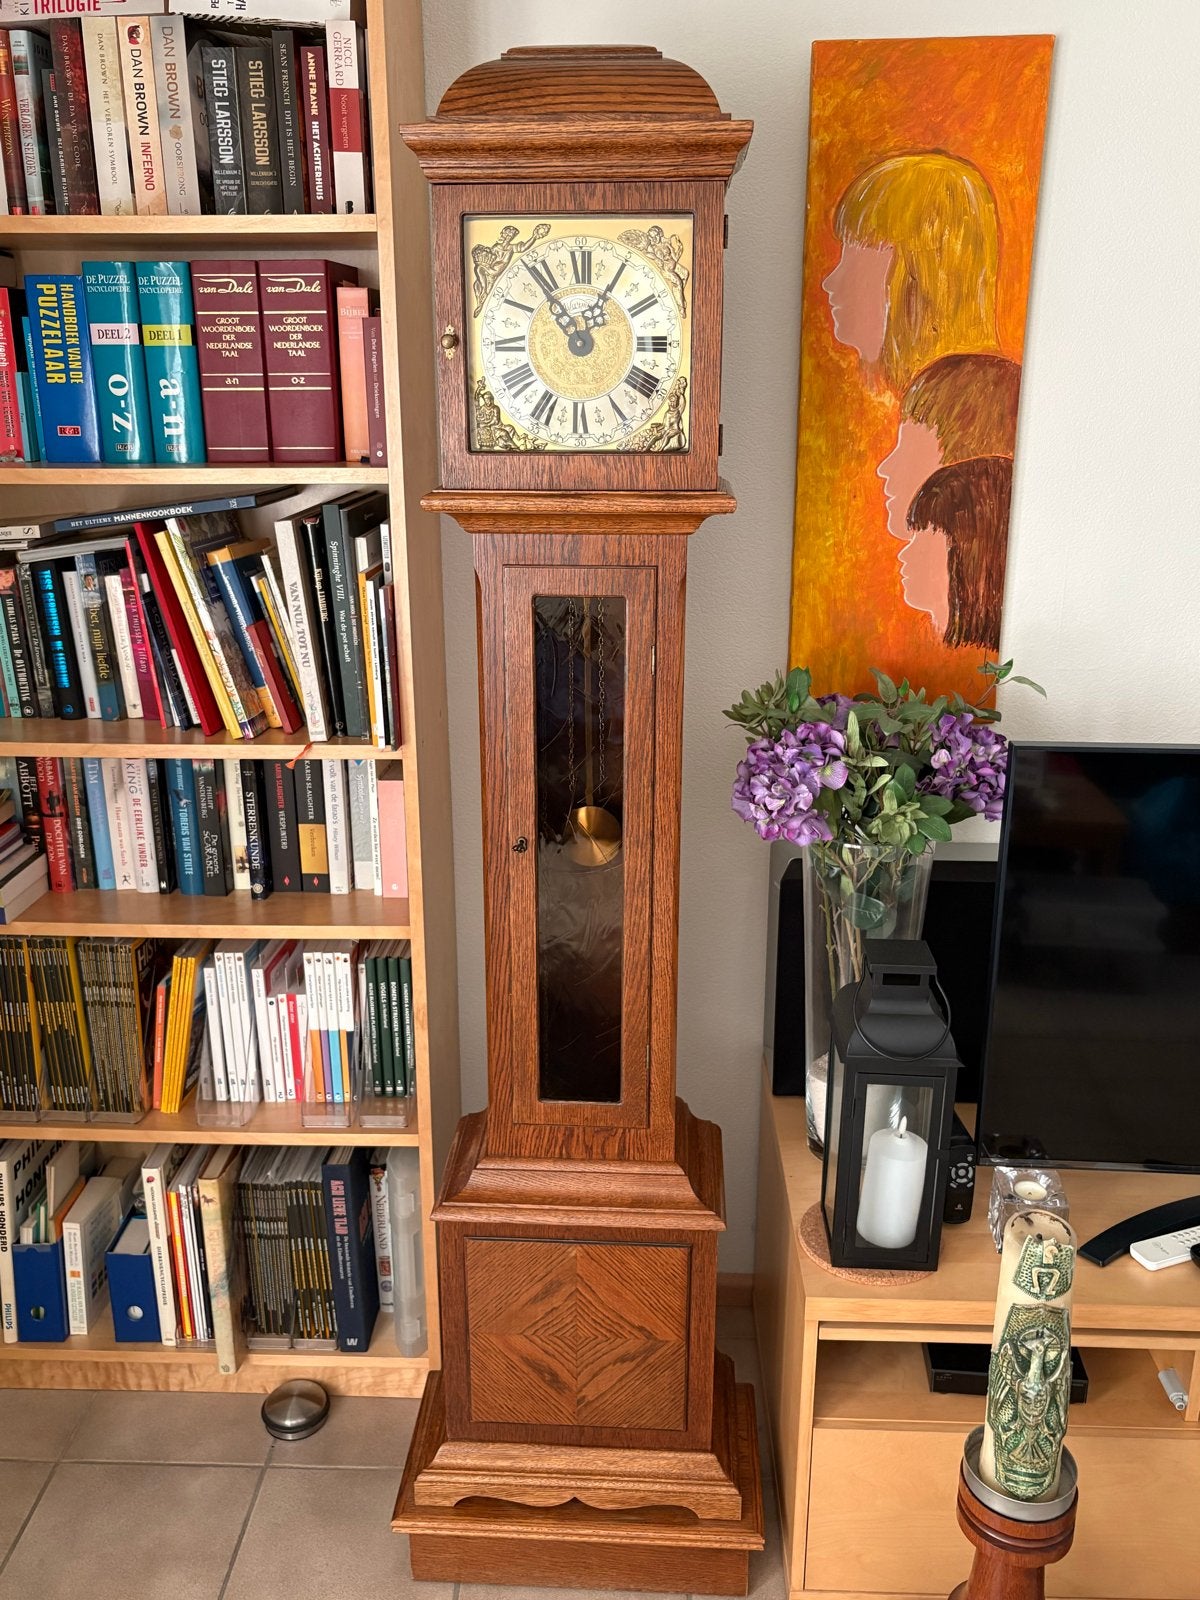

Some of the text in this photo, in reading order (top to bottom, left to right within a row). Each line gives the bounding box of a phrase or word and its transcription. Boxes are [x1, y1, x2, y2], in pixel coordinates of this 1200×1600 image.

[97, 33, 105, 50] DAN
[279, 43, 287, 67] SEAN
[343, 37, 353, 68] NICCI
[100, 53, 108, 85] BROWN
[332, 31, 344, 86] GERRARD
[61, 35, 81, 168] DAN BROWN DE DA VINCI CODE
[281, 69, 291, 105] FRENCH
[131, 48, 155, 191] DAN BROWN INFERNO
[161, 26, 187, 196] DAN BROWN OORSPRONG
[212, 59, 234, 164] STIEG LARSSON
[248, 60, 270, 165] STIEG LARSSON
[307, 51, 324, 201] ANNE FRANK HET ACHTERHUIS
[340, 94, 350, 149] Nooit vergeten
[19, 98, 37, 177] VERLOREN SEIZOEN
[105, 108, 114, 147] VERLOREN
[286, 129, 292, 137] IS
[286, 139, 294, 157] HET
[108, 149, 118, 185] SYMBOOL
[288, 160, 296, 186] BEGIN
[574, 237, 587, 246] 60
[86, 274, 130, 284] DE PUZZEL
[138, 275, 183, 286] DE PUZZEL
[569, 250, 592, 285] XII
[87, 285, 131, 293] ENCYCLOPEDIE
[139, 286, 183, 294] ENCYCLOPEDIE
[215, 278, 254, 294] Dale
[283, 278, 321, 293] Dale
[216, 317, 239, 325] GROOT
[283, 316, 307, 324] GROOT
[628, 293, 659, 318] II
[36, 284, 66, 384] PUZZELAAR
[60, 284, 84, 384] HANDBOEK VAN DE
[97, 328, 131, 340] DEEL 2
[149, 329, 182, 341] DEEL 1
[202, 325, 256, 333] WOORDENBOEK
[273, 341, 321, 349] NEDERLANDSE
[636, 336, 668, 353] III
[221, 350, 239, 358] TAAL
[373, 382, 381, 419] Driekoningen
[574, 438, 587, 447] 30
[85, 517, 112, 525] ULTIEME
[114, 506, 193, 522] MANNENKOOKBOEK
[330, 541, 345, 602] Spinninghe VIII,
[5, 598, 19, 624] NICHOLAS
[289, 581, 310, 668] VAN NUL TOT NU
[9, 624, 20, 644] SPARKS
[38, 569, 70, 688] TESS GERRITSEN DE LEERLING
[93, 629, 105, 650] mijn
[129, 594, 147, 673] FELIX THIJSSEN Tiffany
[339, 609, 351, 662] Wat de pot schaft
[96, 652, 110, 679] liefde
[18, 760, 33, 808] ABBOTT
[29, 776, 37, 793] JEFF
[87, 760, 99, 784] TIM
[126, 763, 139, 795] KING
[198, 776, 207, 819] VANDENBERG
[304, 760, 314, 820] KARIN SLAUGHTER
[46, 832, 53, 842] DE
[77, 831, 85, 858] OORLOGEN
[132, 798, 148, 868] DE EERLIJKE VINDER
[179, 808, 194, 875] TORENS VAN STILTE
[245, 791, 261, 870] STERRENKUNDE
[279, 810, 288, 850] VERSPLINTERD
[54, 819, 67, 875] DOCHTER VAN
[203, 830, 215, 878] SCARABEE
[210, 834, 220, 874] De groene
[331, 1180, 348, 1235] ACH LIEVE TIJD
[375, 1195, 389, 1249] NEDERLAND
[4, 1303, 13, 1330] PHILIPS
